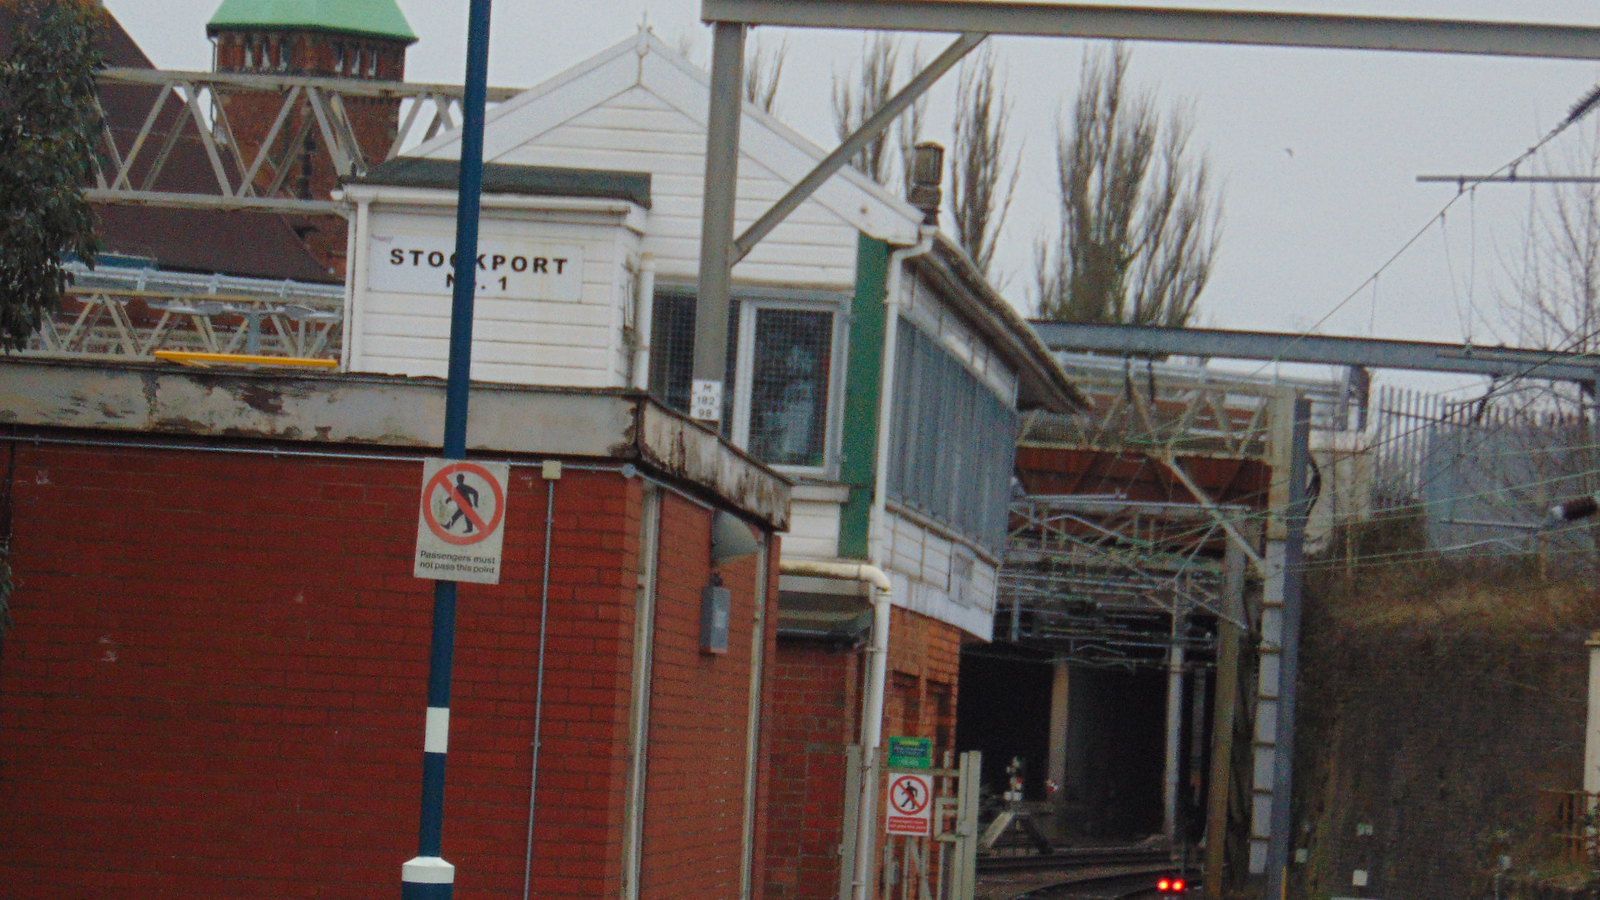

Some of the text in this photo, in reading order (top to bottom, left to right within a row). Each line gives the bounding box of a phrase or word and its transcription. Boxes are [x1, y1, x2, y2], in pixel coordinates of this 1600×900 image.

[446, 273, 508, 291] N. 1
[420, 550, 495, 564] Passengers must
